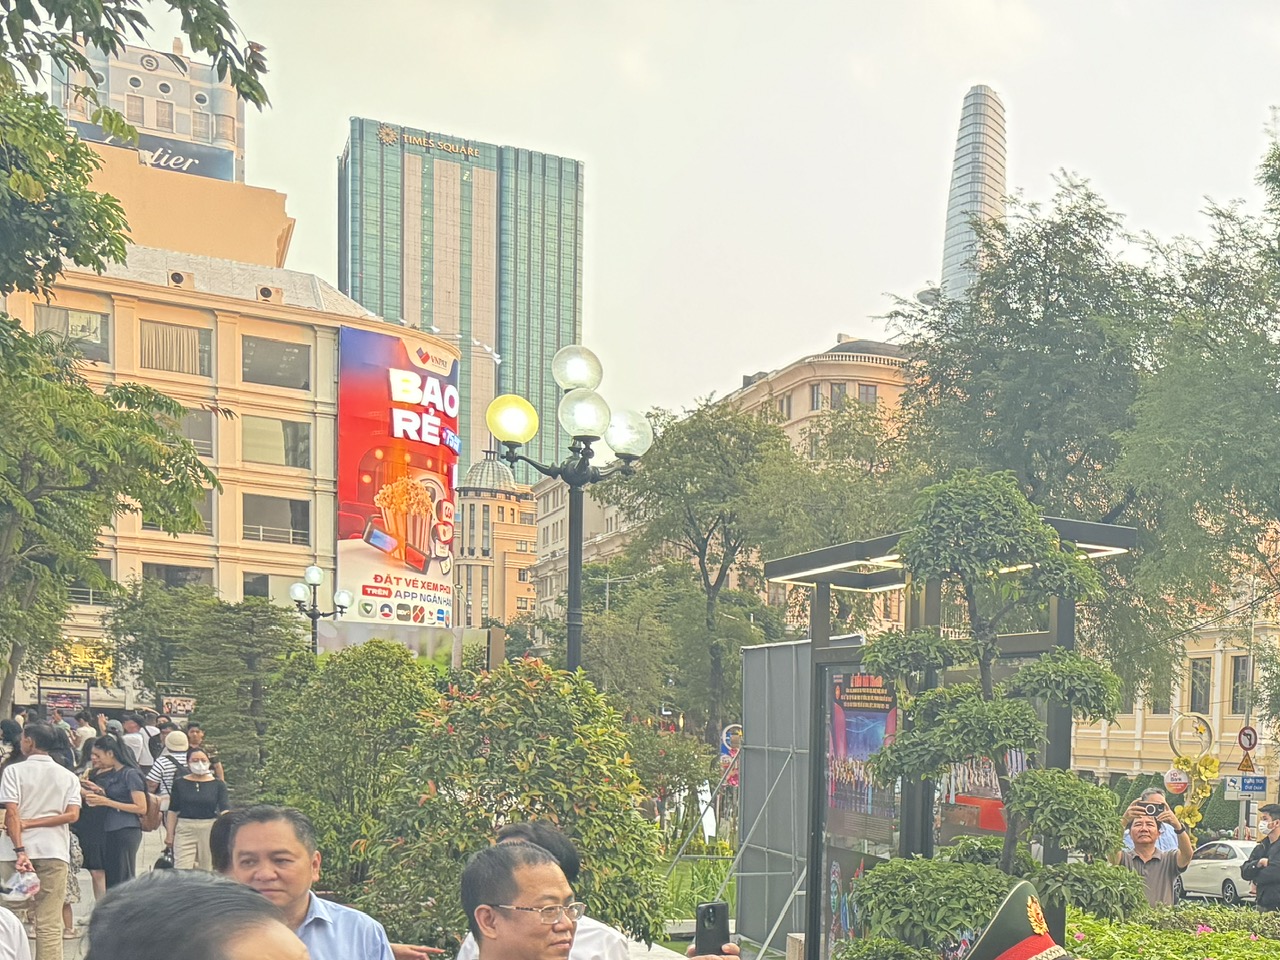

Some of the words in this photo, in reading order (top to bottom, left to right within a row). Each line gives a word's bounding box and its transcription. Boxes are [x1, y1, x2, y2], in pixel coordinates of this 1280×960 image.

[403, 134, 434, 148] TIMES
[438, 142, 480, 157] SQUARE
[390, 368, 460, 418] BAO
[392, 408, 441, 446] RẺ
[373, 574, 402, 586] ĐẶT
[404, 576, 418, 588] VÉ
[420, 580, 439, 592] XEM
[366, 587, 388, 596] TRÊN
[394, 590, 418, 600] APP
[420, 592, 441, 605] NGÂN
